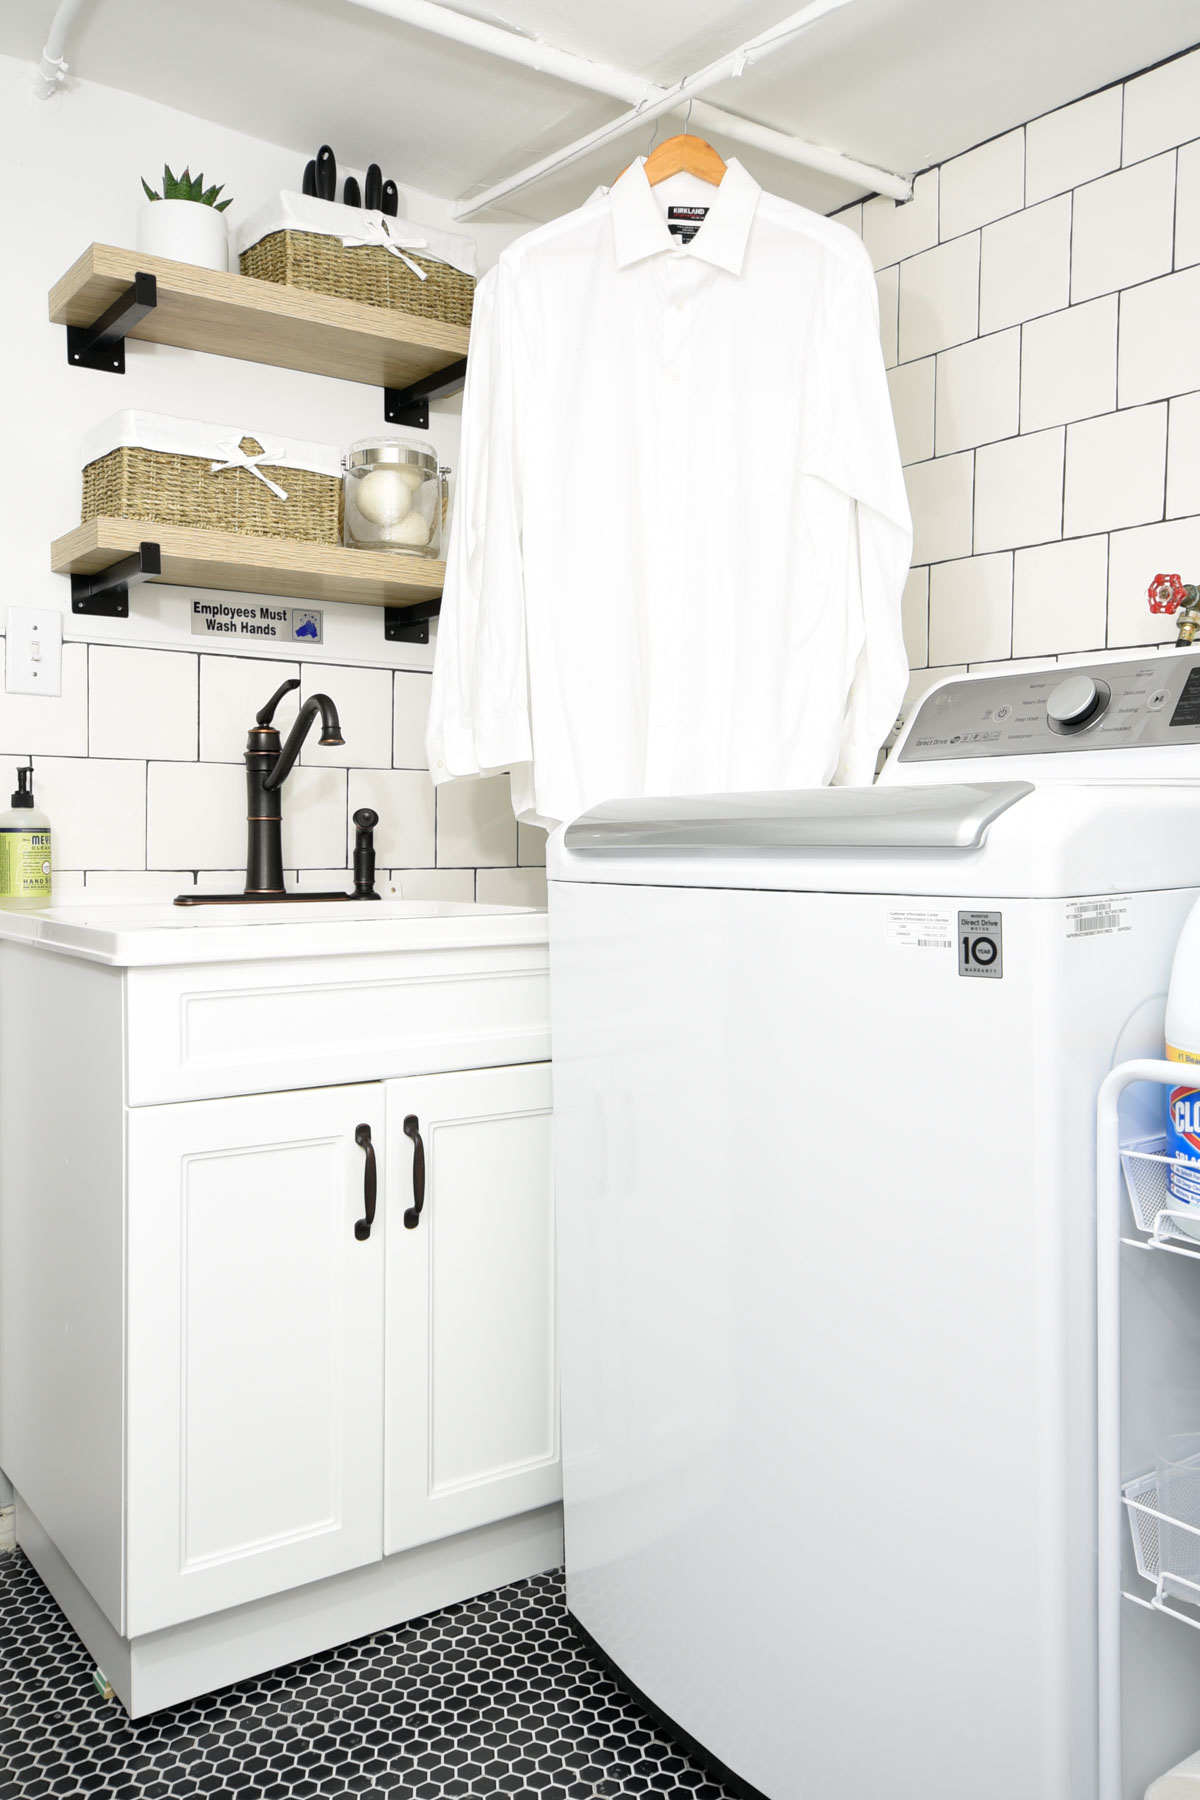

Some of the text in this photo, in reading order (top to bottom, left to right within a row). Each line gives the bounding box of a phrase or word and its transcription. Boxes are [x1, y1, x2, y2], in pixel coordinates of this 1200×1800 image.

[193, 601, 287, 621] Employees Must
[206, 618, 276, 636] Wash Hands
[961, 918, 998, 927] Direct Drive
[962, 936, 998, 966] 10
